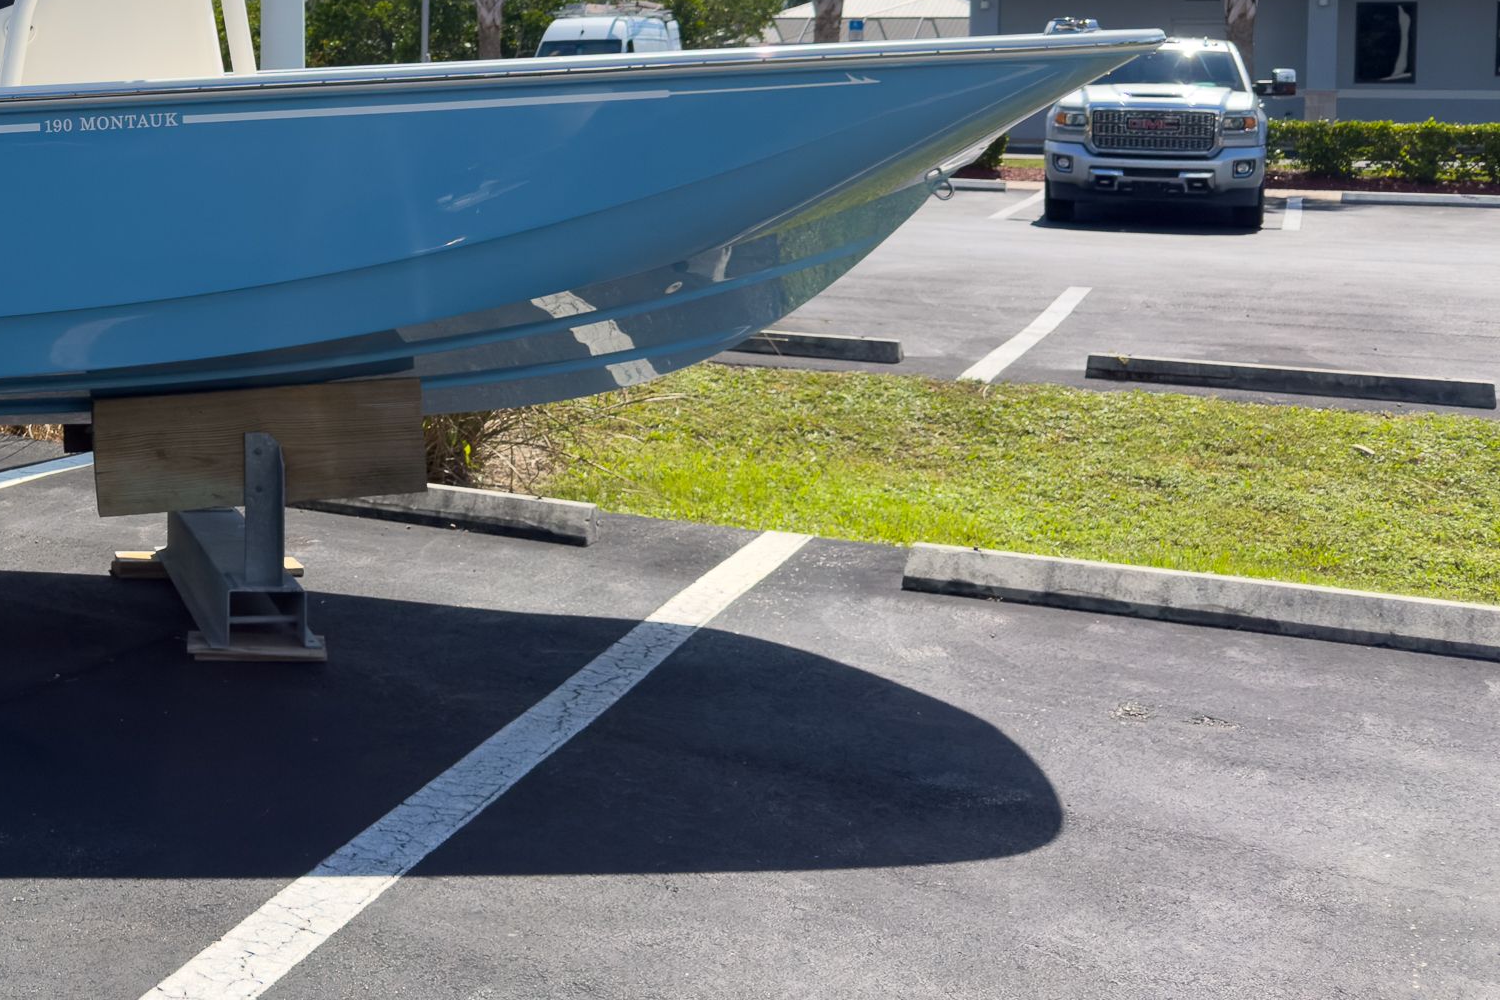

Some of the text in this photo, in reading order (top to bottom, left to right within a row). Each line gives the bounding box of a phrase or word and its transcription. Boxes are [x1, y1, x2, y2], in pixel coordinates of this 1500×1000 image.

[44, 112, 179, 133] 190 MONTAUK
[1128, 118, 1179, 130] GMC
